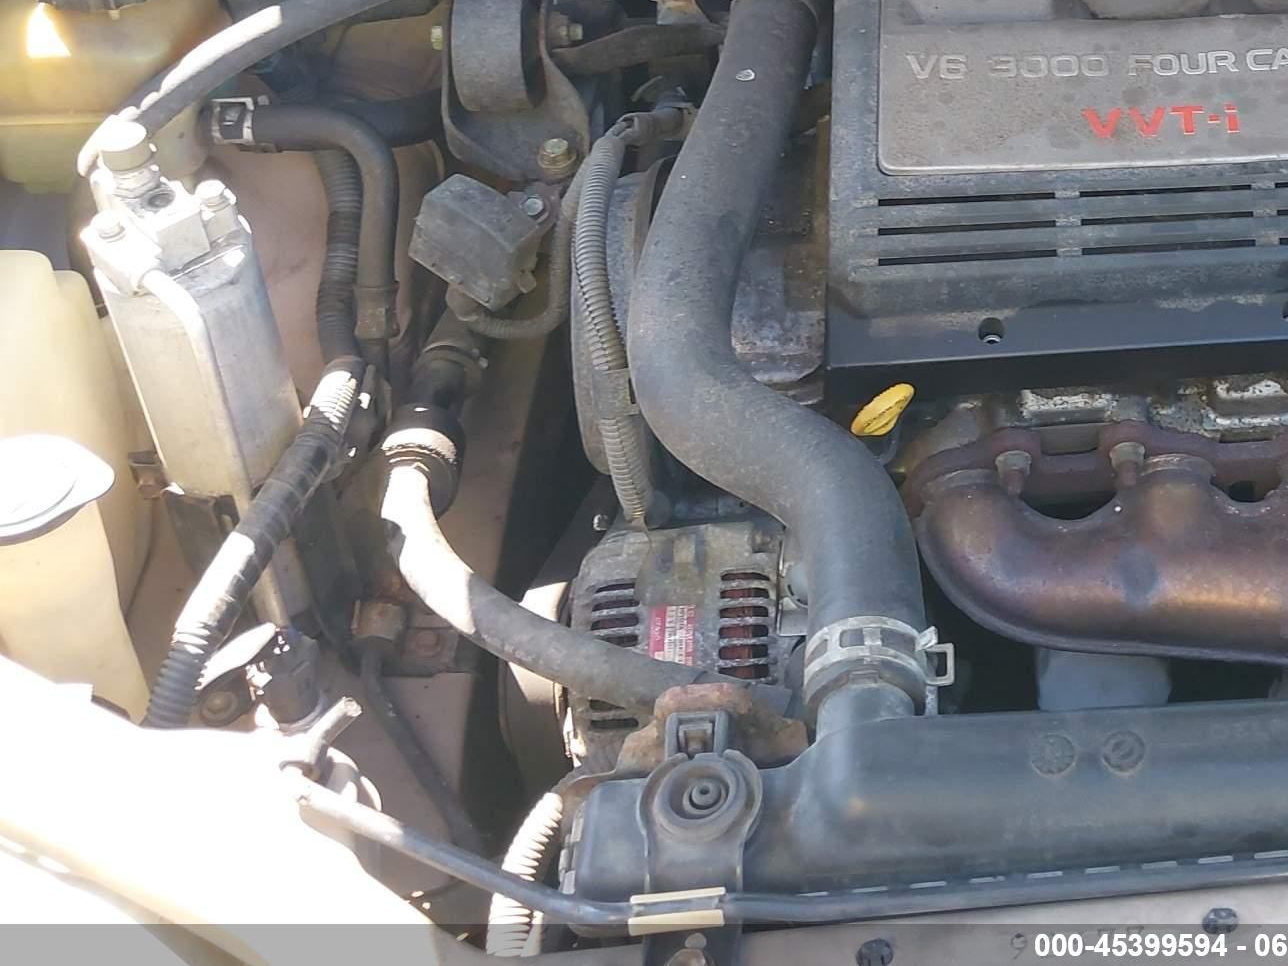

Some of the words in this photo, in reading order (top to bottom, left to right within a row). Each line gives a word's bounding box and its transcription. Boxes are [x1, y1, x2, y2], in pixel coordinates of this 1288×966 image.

[906, 53, 968, 80] V6
[988, 52, 1108, 79] 3000
[1128, 50, 1239, 77] FOUR
[1082, 103, 1242, 139] VVT-i
